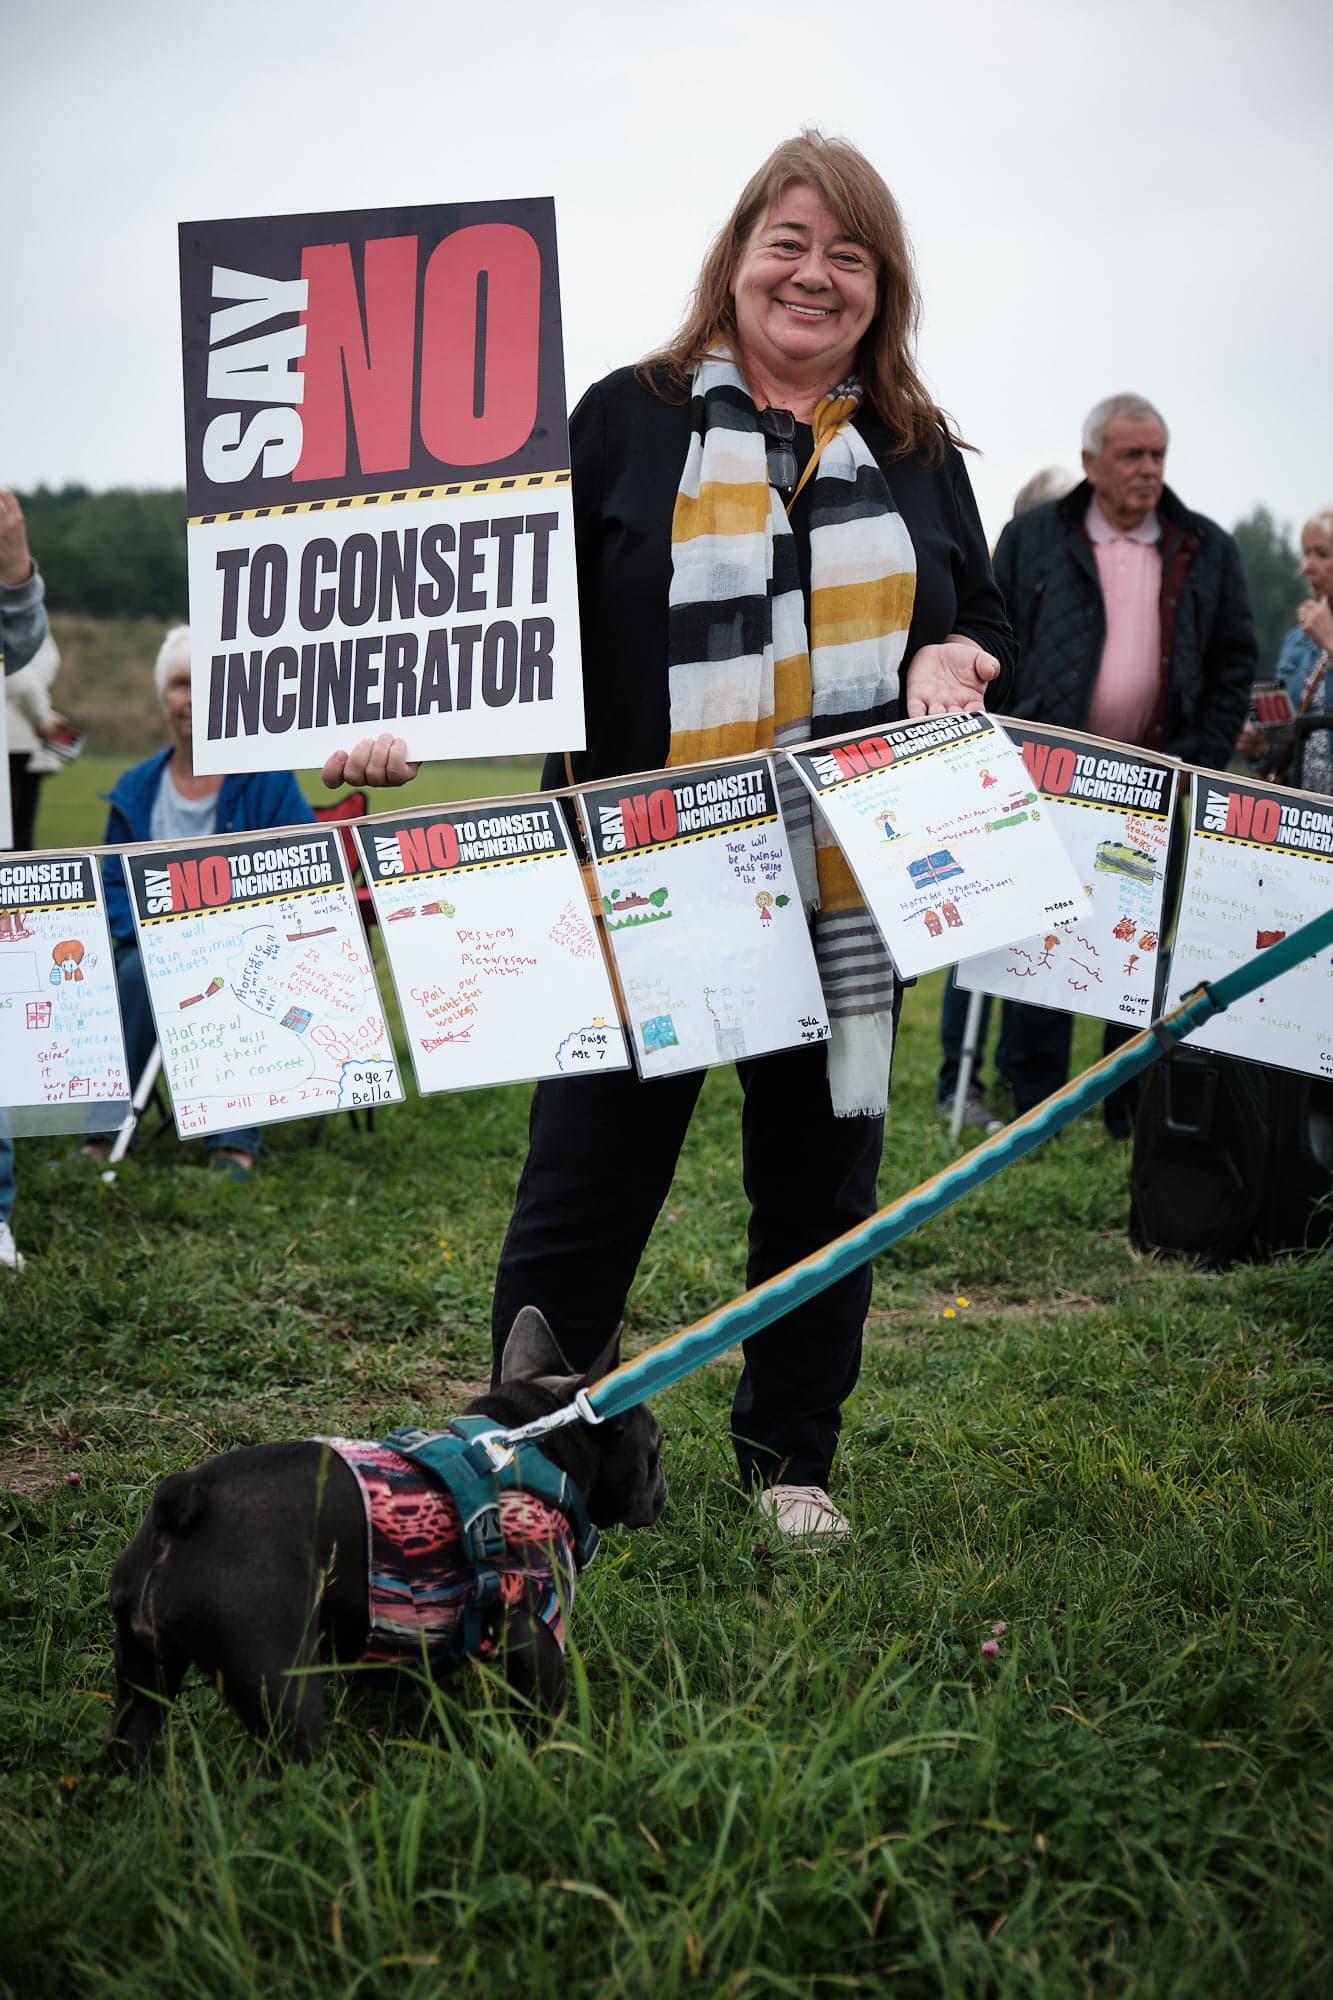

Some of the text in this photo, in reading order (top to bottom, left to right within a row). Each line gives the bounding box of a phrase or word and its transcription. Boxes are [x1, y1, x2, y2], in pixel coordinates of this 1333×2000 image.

[291, 222, 541, 482] NO
[202, 265, 309, 484] SAY
[215, 511, 559, 641] TO CONSETT
[206, 615, 555, 741] INCINERATOR
[882, 712, 974, 747] TO CONSETT
[893, 718, 983, 759] INCINERATOR
[809, 753, 845, 786] SAY
[829, 736, 896, 780] NO
[1021, 741, 1076, 795] NO
[1075, 754, 1168, 791] TO CONSETT
[672, 768, 765, 809] TO CONSETT
[1069, 775, 1163, 810] INCINERATOR
[454, 810, 550, 843] TO CONSETT
[598, 806, 627, 852] SAY
[618, 788, 680, 850] NO
[677, 793, 767, 833] INCINERATOR
[1202, 789, 1231, 832] SAY
[1222, 792, 1282, 844] NO
[1280, 805, 1333, 834] TO CON
[227, 840, 329, 878] TO CONSETT
[373, 836, 405, 877] SAY
[394, 822, 461, 874] NO
[459, 830, 556, 862] INCINERATOR
[0, 861, 83, 887] CONSETT
[0, 881, 84, 905] INERATOR
[144, 868, 175, 915] SAY
[166, 855, 233, 913] NO
[231, 862, 333, 899] INCINERATOR
[352, 1084, 392, 1106] Bella
[353, 1069, 395, 1085] age 7
[227, 1097, 252, 1109] will
[179, 1118, 207, 1131] tall
